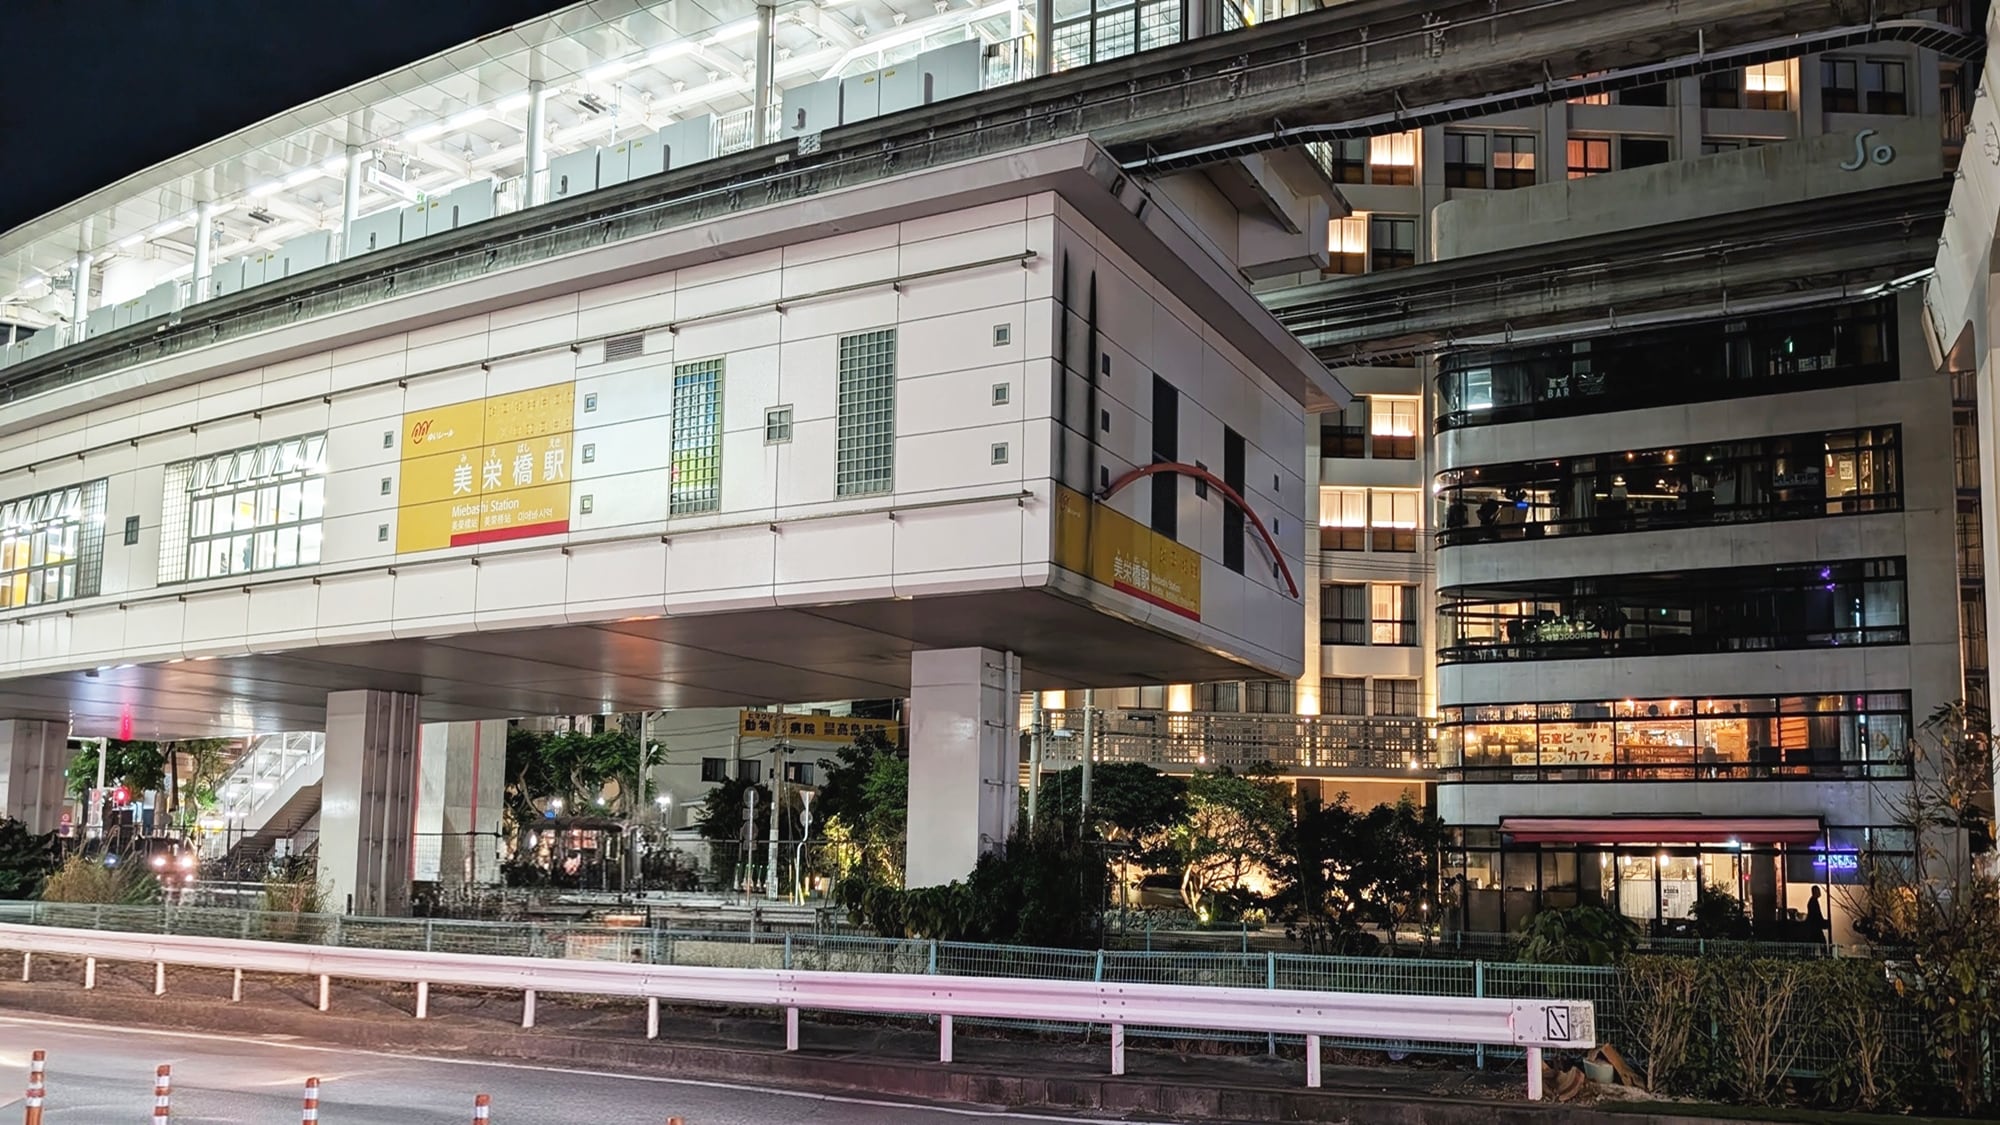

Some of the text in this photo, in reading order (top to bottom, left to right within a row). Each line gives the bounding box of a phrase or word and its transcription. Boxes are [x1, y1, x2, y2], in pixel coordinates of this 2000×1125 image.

[1547, 387, 1569, 398] BAR
[453, 448, 565, 495] 美栄橋駅
[451, 498, 519, 518] Miebashi Station
[745, 719, 770, 732] 動物
[790, 722, 815, 735] 病院
[1540, 732, 1608, 744] 石窯ピッツァ
[1567, 750, 1601, 762] カフェ
